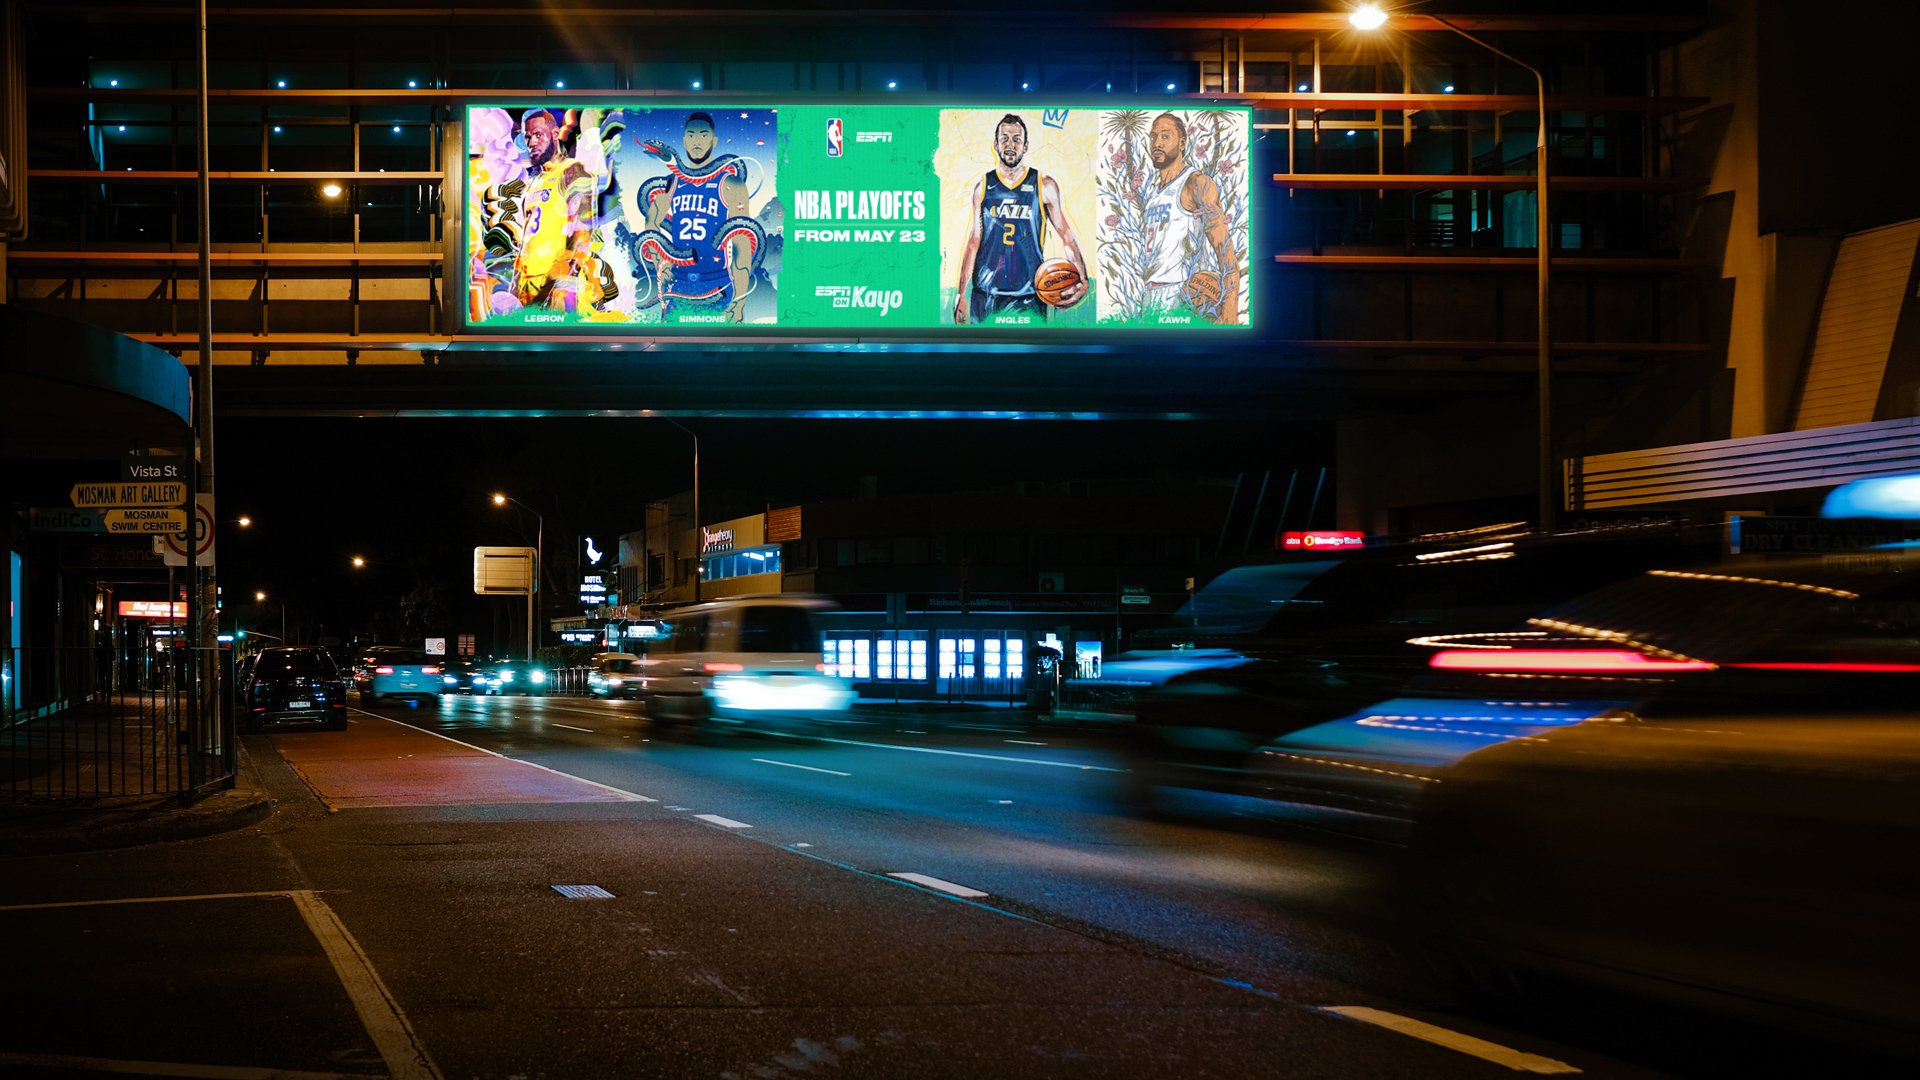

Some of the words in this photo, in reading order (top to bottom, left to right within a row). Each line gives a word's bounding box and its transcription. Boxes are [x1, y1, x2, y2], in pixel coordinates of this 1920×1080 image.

[856, 131, 892, 142] ESPN
[672, 194, 719, 217] PHILA
[794, 190, 832, 220] NBA
[835, 190, 926, 220] PLAYOFFS
[679, 217, 707, 241] 25
[1002, 223, 1015, 246] 2
[794, 229, 851, 242] FROM
[854, 229, 896, 242] MAY
[899, 229, 926, 242] 23
[815, 286, 851, 296] ESPN
[834, 299, 849, 307] ON
[851, 286, 903, 317] Kayo
[524, 315, 565, 323] LEBRON
[679, 315, 726, 323] SIMMONS
[994, 316, 1031, 325] INGLES
[1157, 316, 1191, 325] KAWHI
[130, 465, 161, 478] Vista
[164, 465, 178, 477] St
[77, 486, 116, 504] MOSMAN
[120, 486, 138, 503] ART
[141, 484, 181, 503] GALLERY
[124, 510, 169, 520] MOSMAN
[111, 522, 138, 531] SWIM
[142, 522, 182, 531] CENTRE
